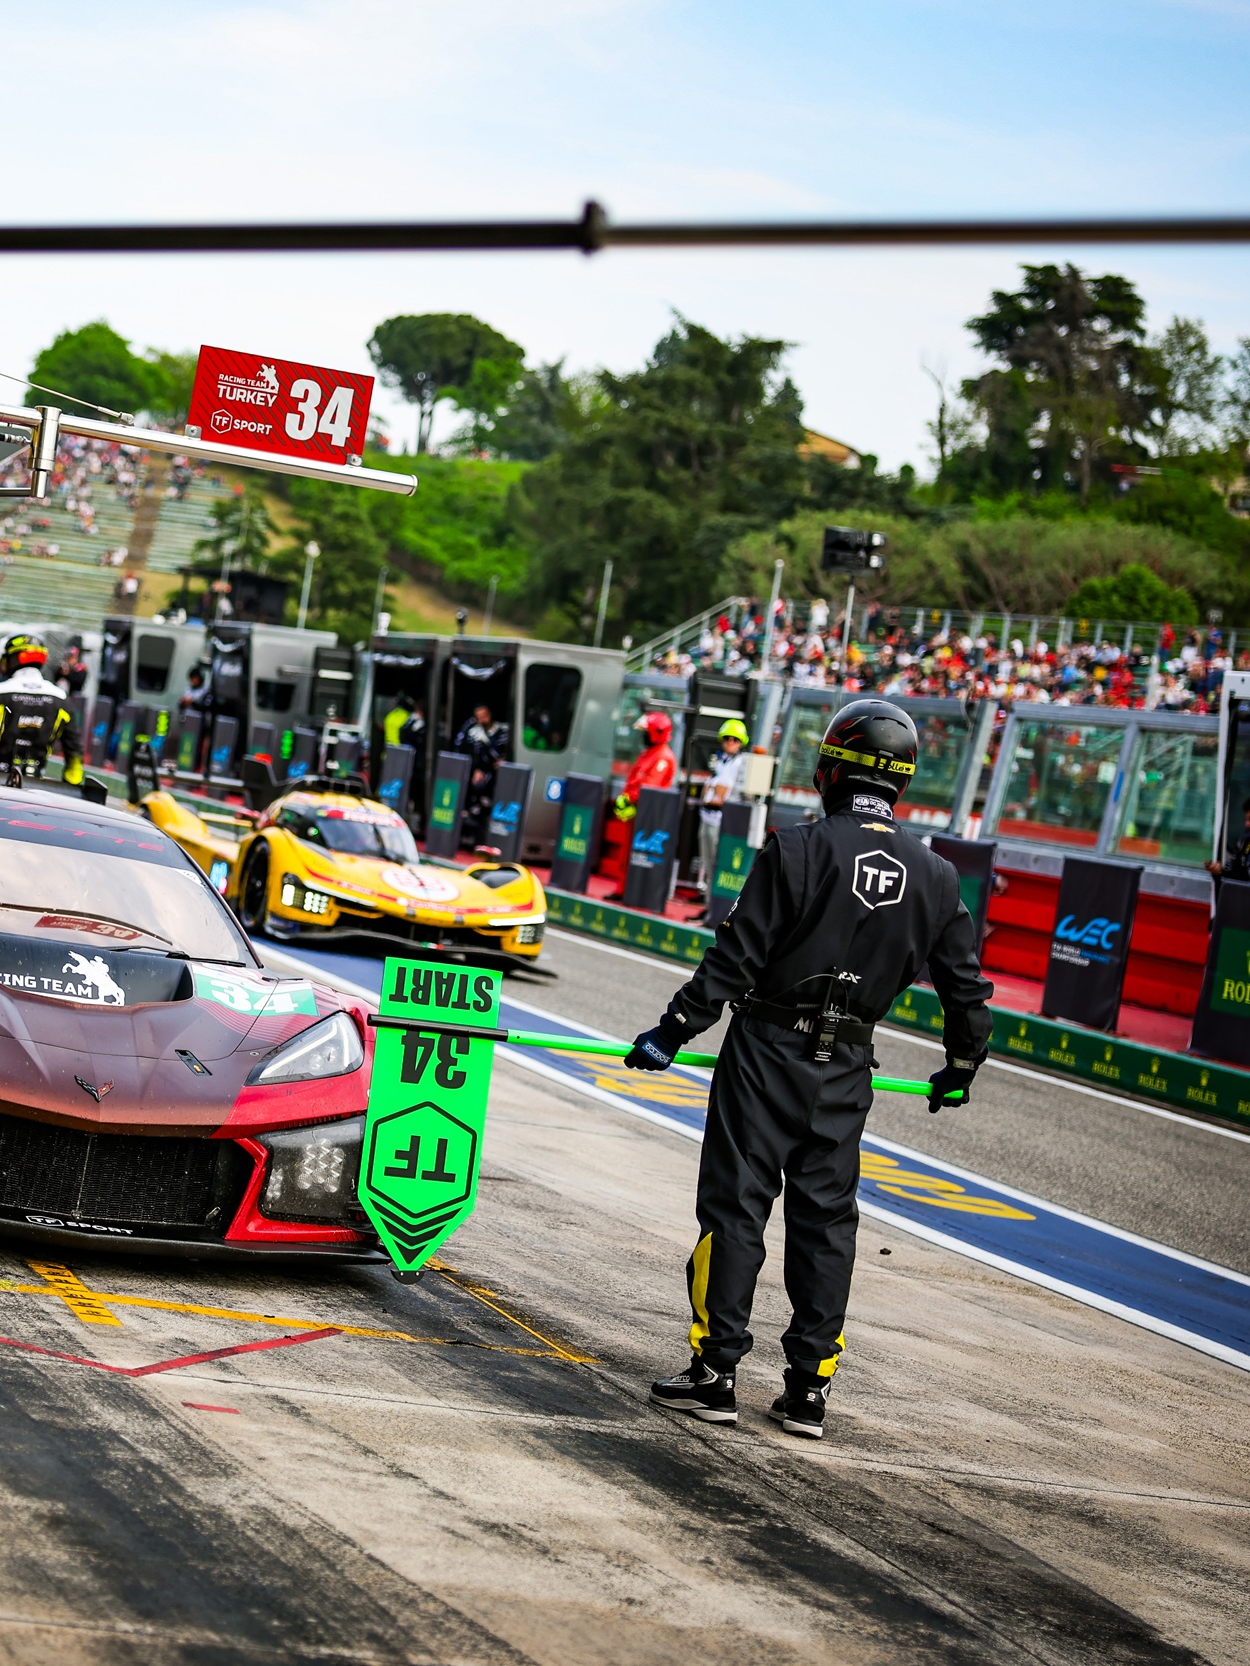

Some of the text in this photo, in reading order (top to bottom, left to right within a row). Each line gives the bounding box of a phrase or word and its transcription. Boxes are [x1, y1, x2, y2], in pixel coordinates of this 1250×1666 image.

[218, 374, 267, 388] RACING TEAM
[217, 385, 277, 407] TURKEY
[285, 379, 354, 447] 34
[214, 415, 273, 435] TF SPORT
[862, 865, 899, 894] TF
[1054, 914, 1121, 950] WEC
[40, 977, 93, 998] TEAM
[210, 980, 298, 1013] 34
[389, 966, 494, 1013] START
[400, 1029, 470, 1089] 34
[1092, 1060, 1120, 1079] ROLEX
[1138, 1072, 1168, 1092] ROLEX
[1187, 1086, 1217, 1106] ROLEX
[384, 1135, 456, 1183] TF
[66, 1221, 133, 1235] SPORT
